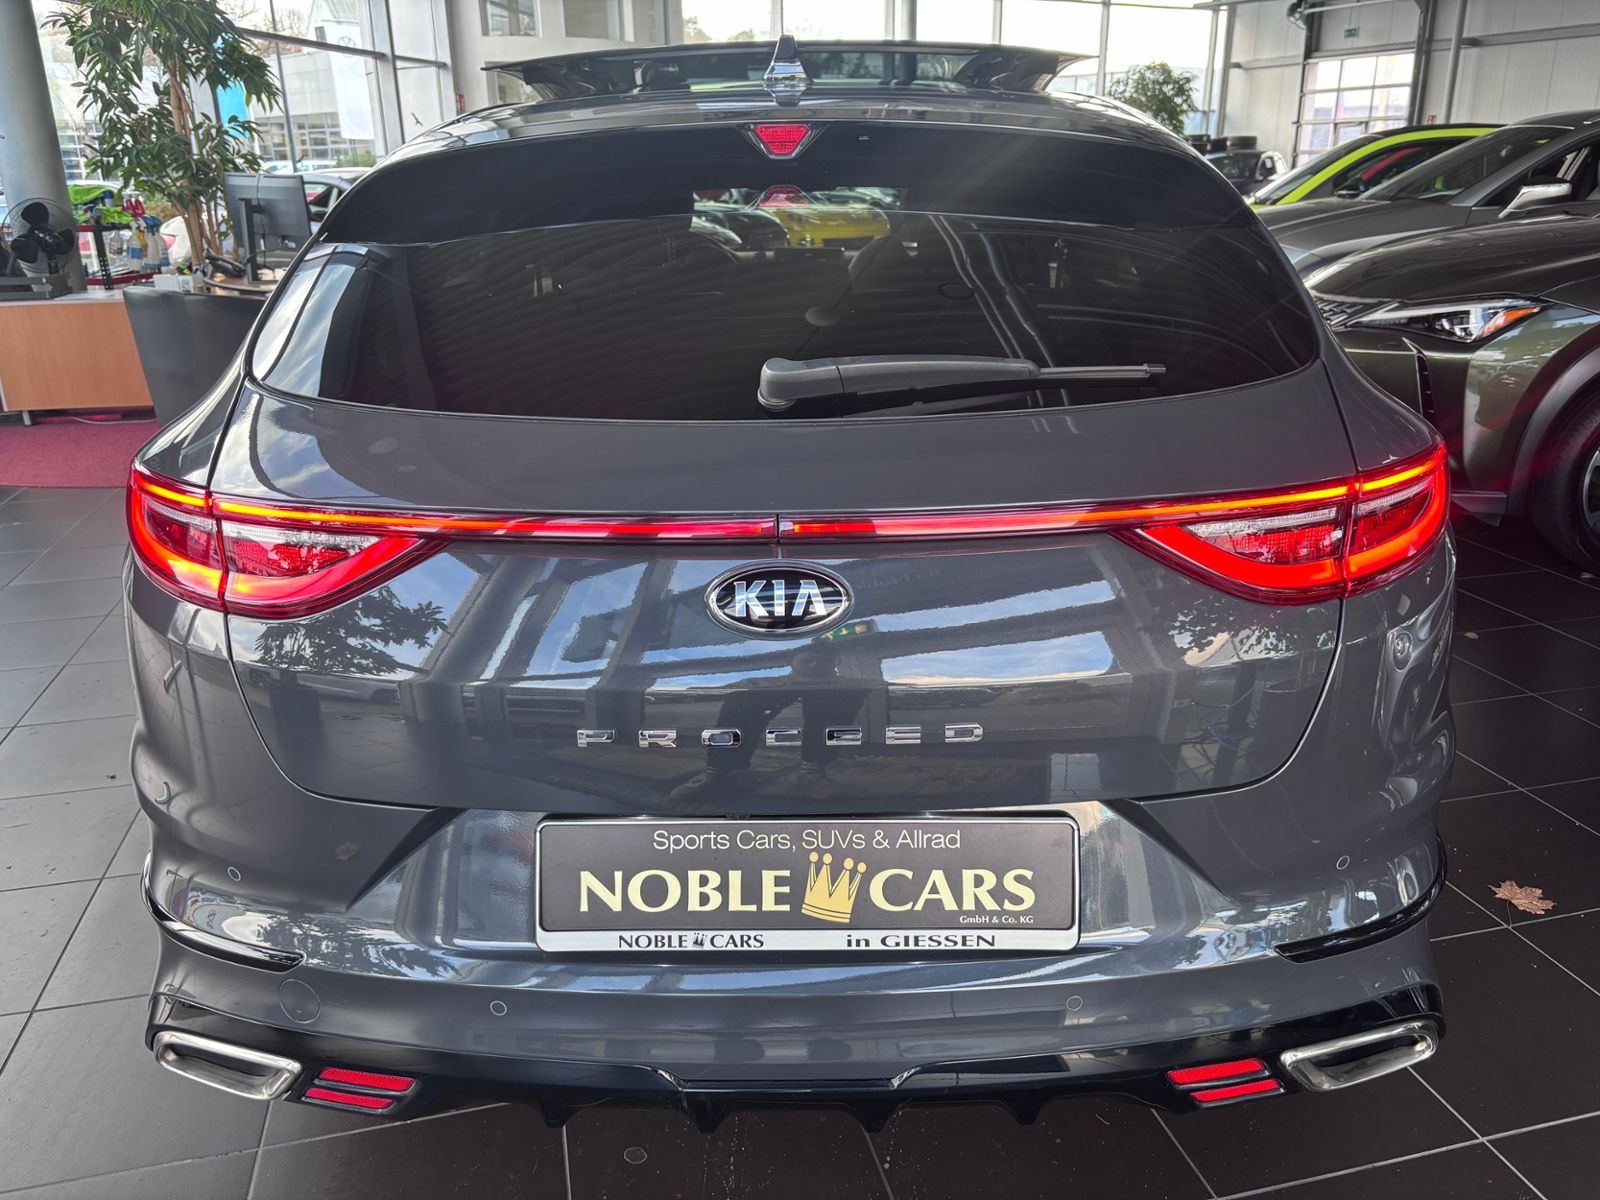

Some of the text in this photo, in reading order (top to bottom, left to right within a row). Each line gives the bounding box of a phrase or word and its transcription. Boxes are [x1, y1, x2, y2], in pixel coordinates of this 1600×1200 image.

[733, 579, 828, 617] KIA
[576, 722, 985, 748] PROCEED
[653, 828, 961, 853] Sports Cars, SUVs & Allrad
[579, 867, 1037, 912] NOBLE CARS
[959, 915, 1034, 924] GmbH & Co. KG
[618, 933, 997, 949] NOBLE CARS in GIESSEN
